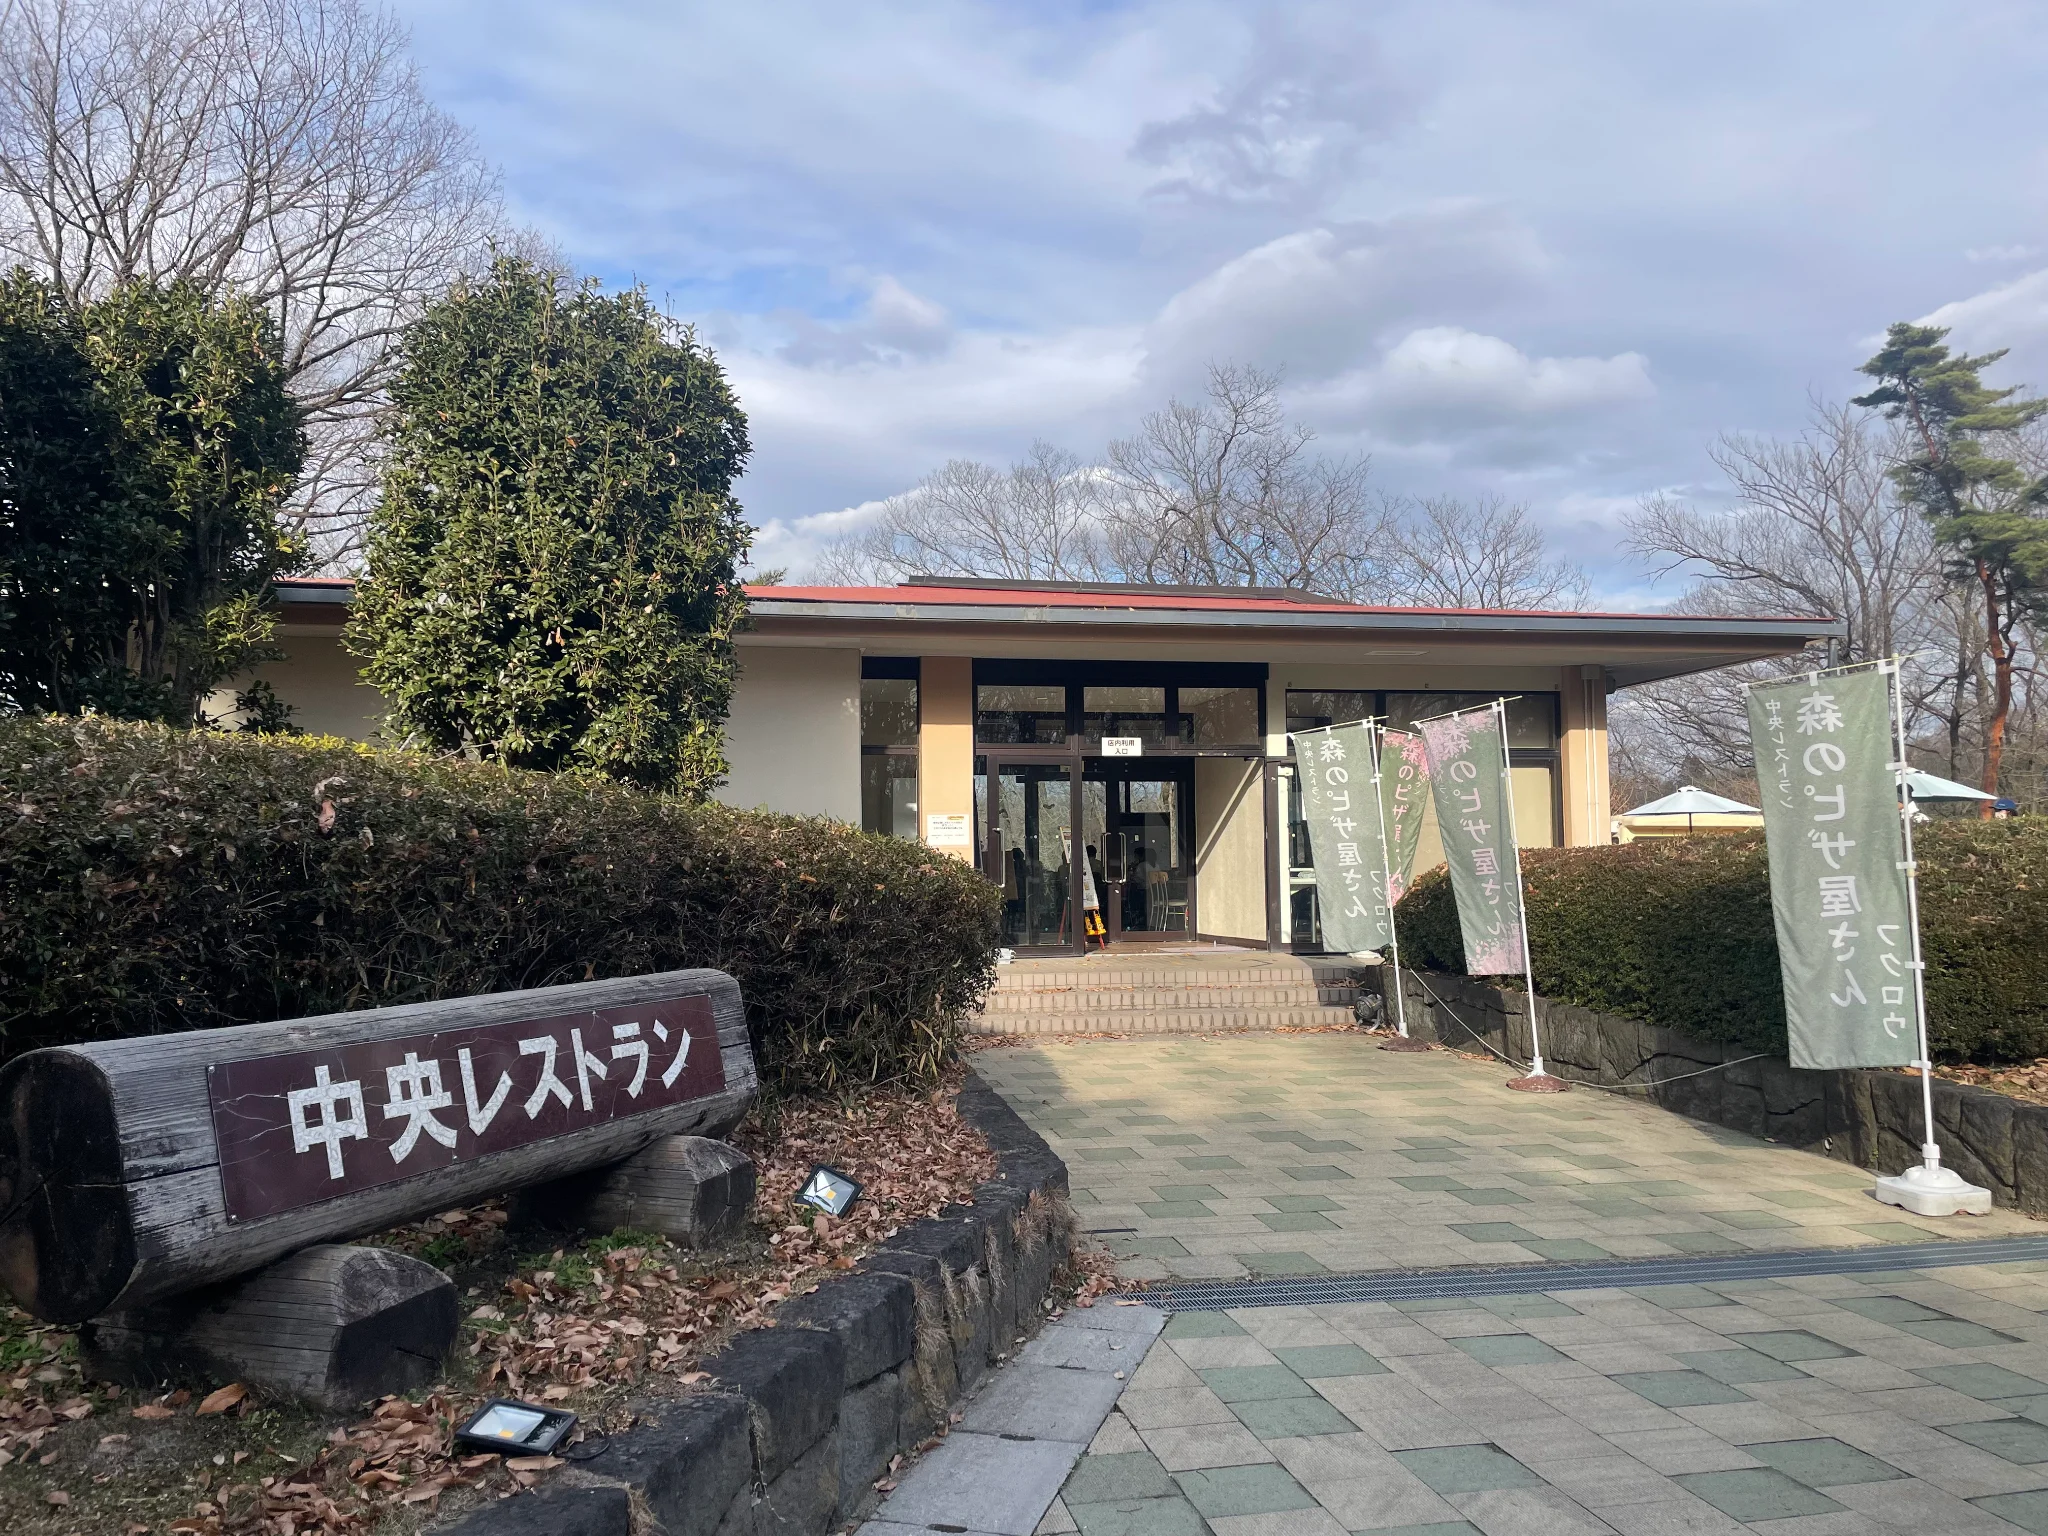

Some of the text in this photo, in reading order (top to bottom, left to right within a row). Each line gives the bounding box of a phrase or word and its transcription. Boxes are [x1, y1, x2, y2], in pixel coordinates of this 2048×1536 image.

[286, 1018, 691, 1181] 中央レストラン
